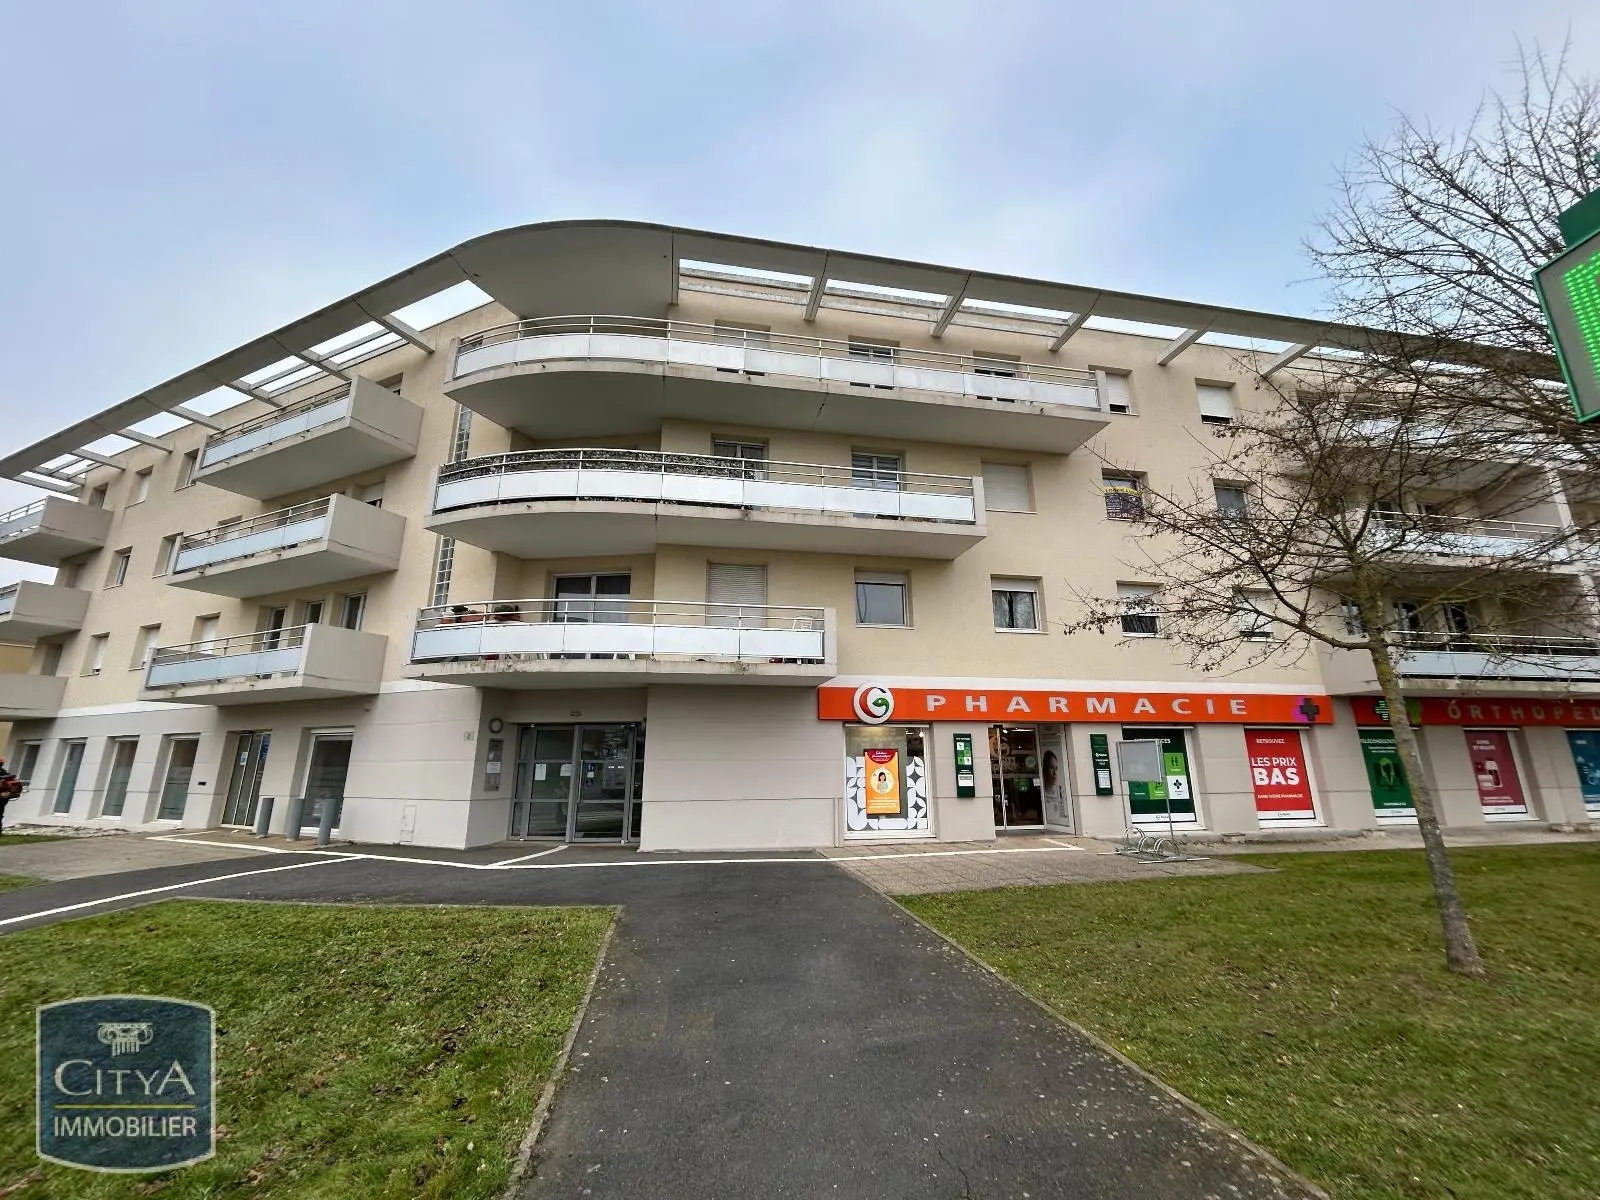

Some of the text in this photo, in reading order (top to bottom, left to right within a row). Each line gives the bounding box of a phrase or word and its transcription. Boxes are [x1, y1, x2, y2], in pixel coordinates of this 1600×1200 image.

[926, 694, 1248, 715] PHARMACIE
[1251, 756, 1297, 767] LES PRIX
[1253, 767, 1300, 786] BAS
